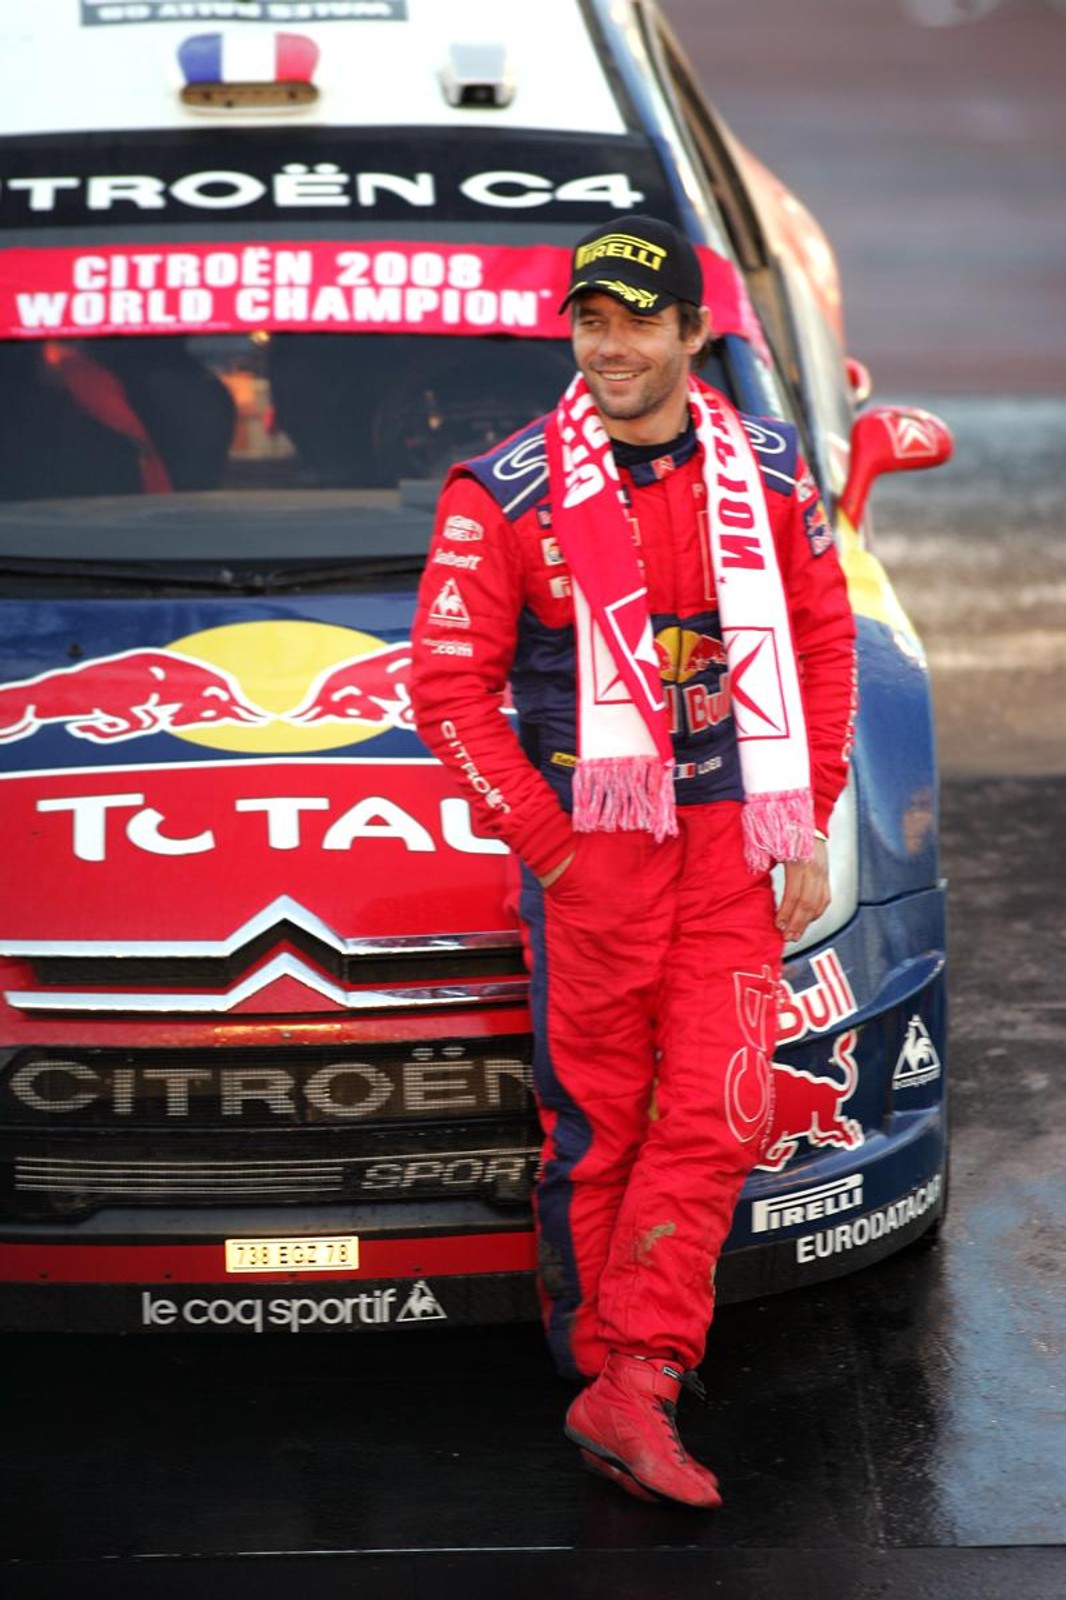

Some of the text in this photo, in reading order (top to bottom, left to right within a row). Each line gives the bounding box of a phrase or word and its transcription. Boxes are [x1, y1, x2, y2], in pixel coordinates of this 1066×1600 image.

[0, 163, 645, 211] TROËN C4
[73, 246, 483, 290] CITROËN 2008
[575, 233, 667, 271] PIRELLI
[15, 286, 539, 328] WORLD CHAMPION
[752, 1173, 864, 1233] PIRELLI
[142, 1288, 397, 1333] le coq sportif
